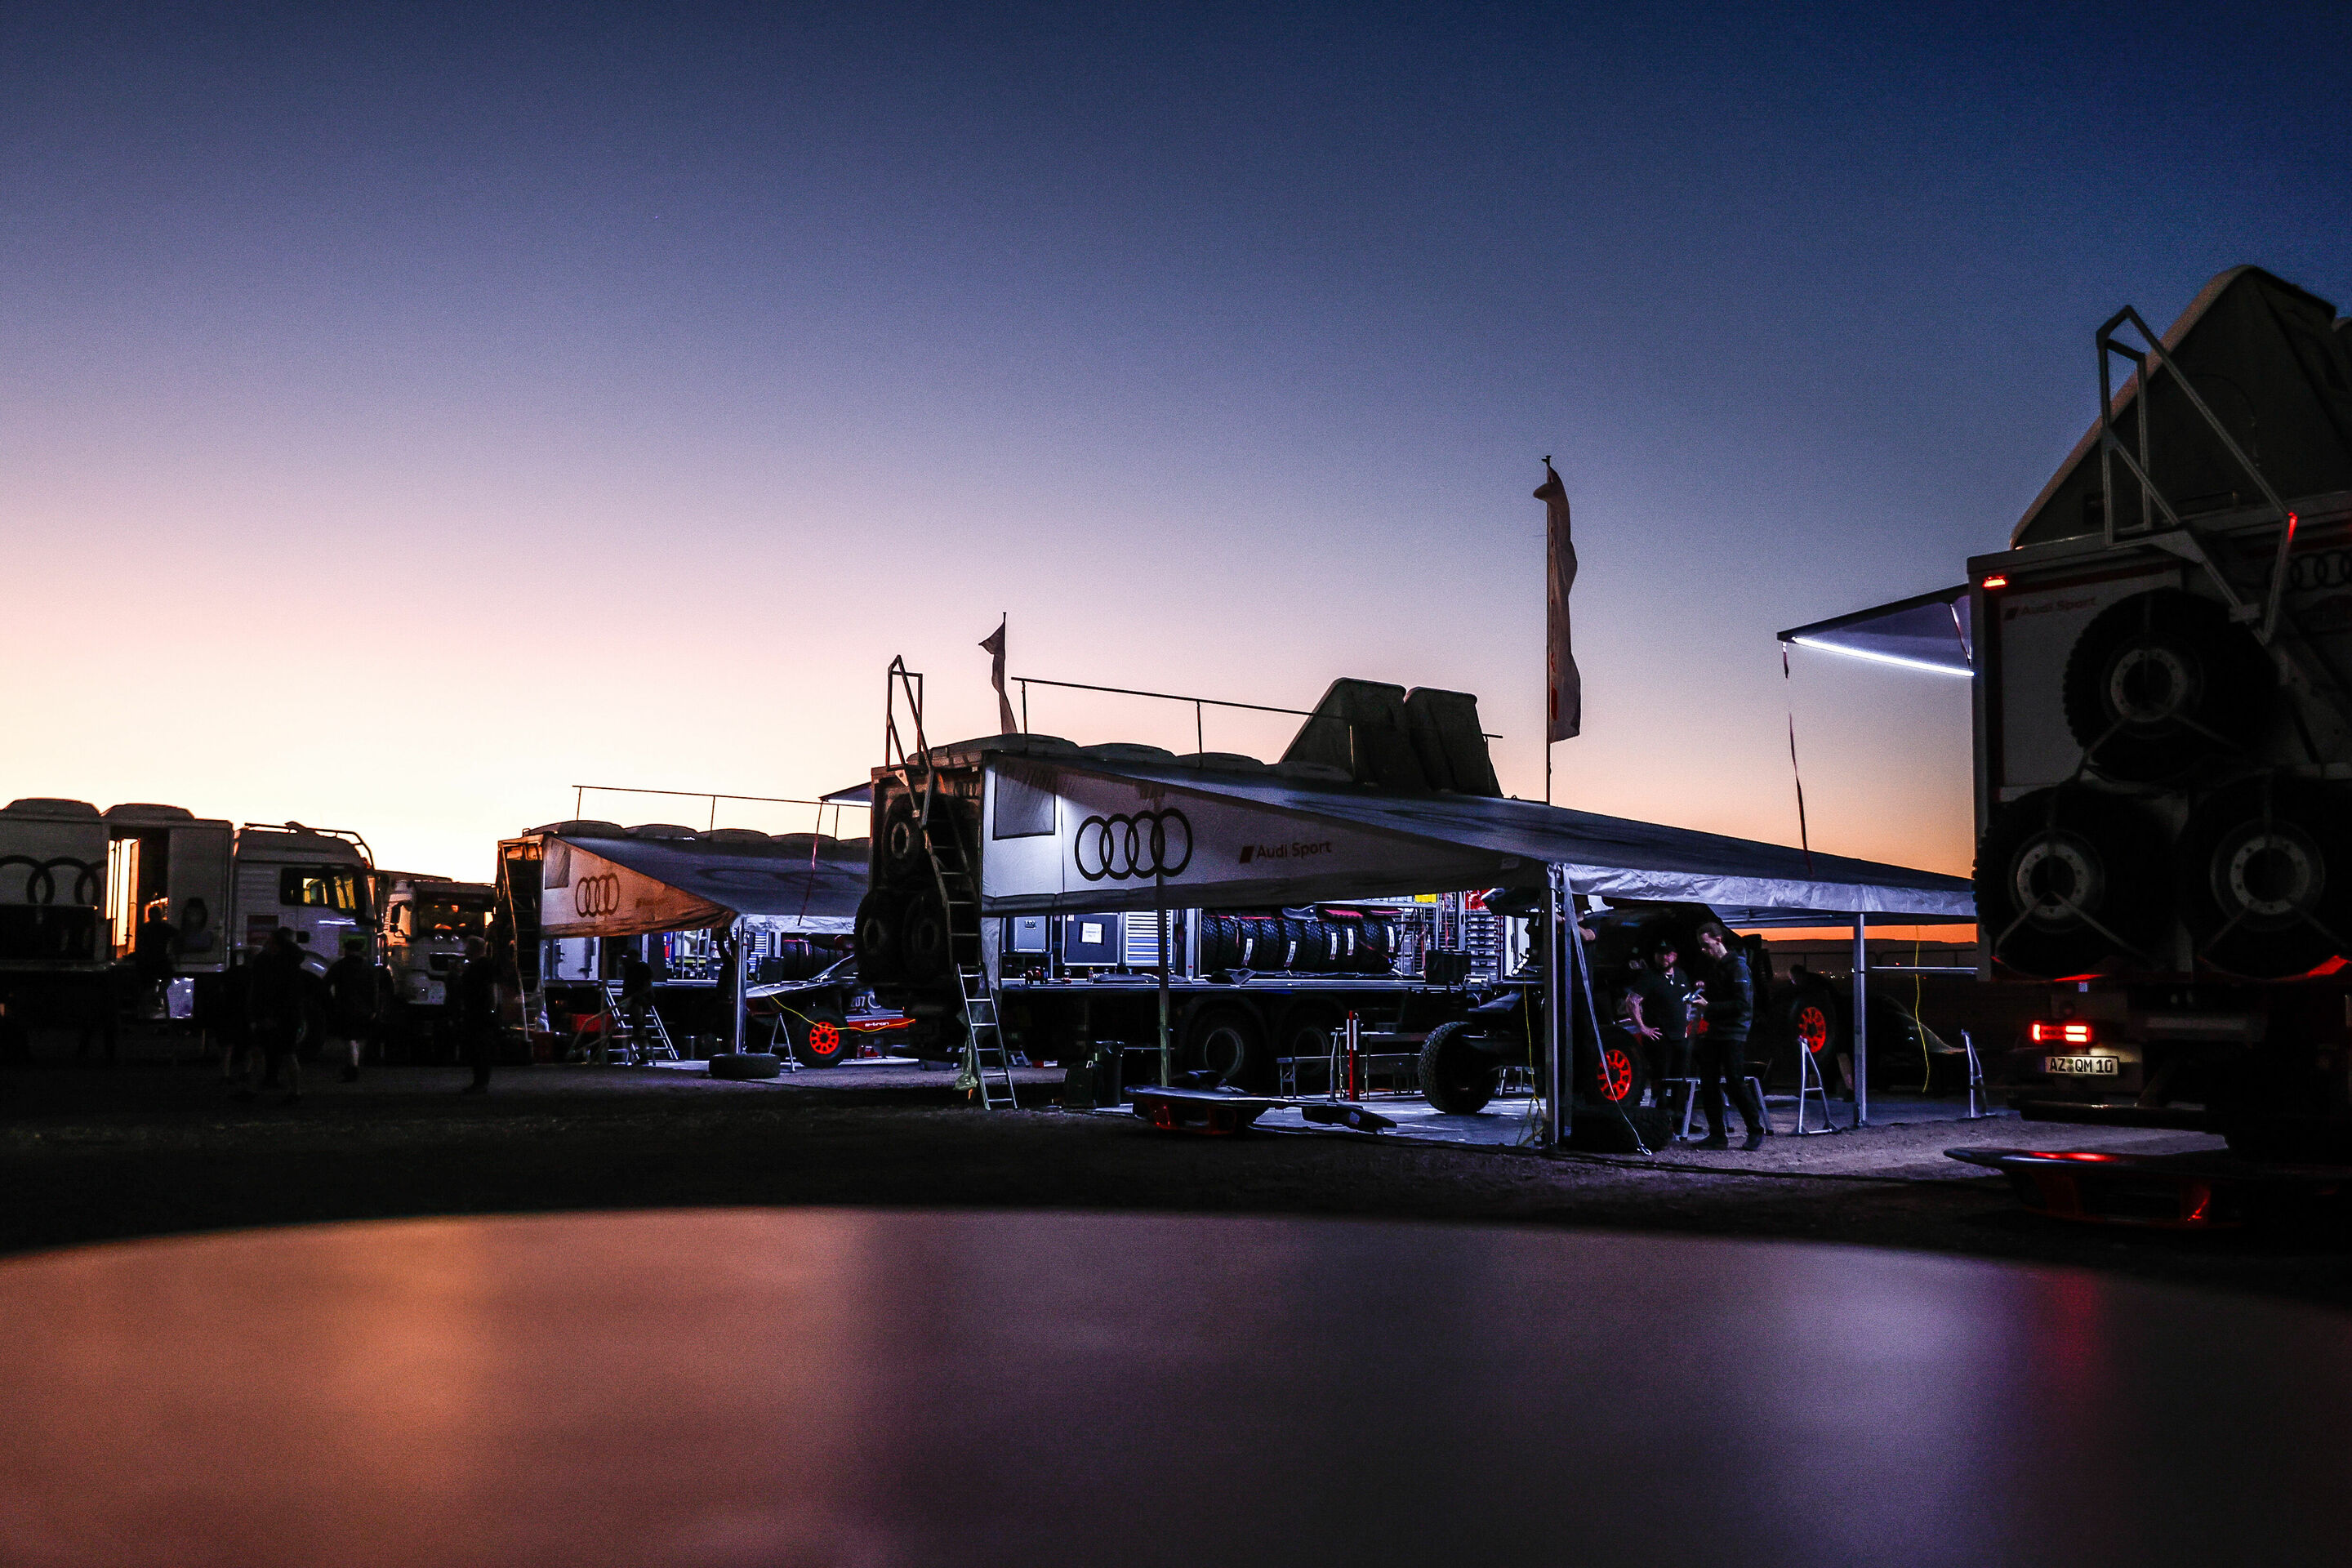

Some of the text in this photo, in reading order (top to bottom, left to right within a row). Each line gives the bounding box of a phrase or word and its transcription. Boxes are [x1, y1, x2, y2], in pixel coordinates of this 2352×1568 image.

[1257, 841, 1333, 860] Audi Sport
[2050, 1058, 2113, 1073] AZ QM 10
